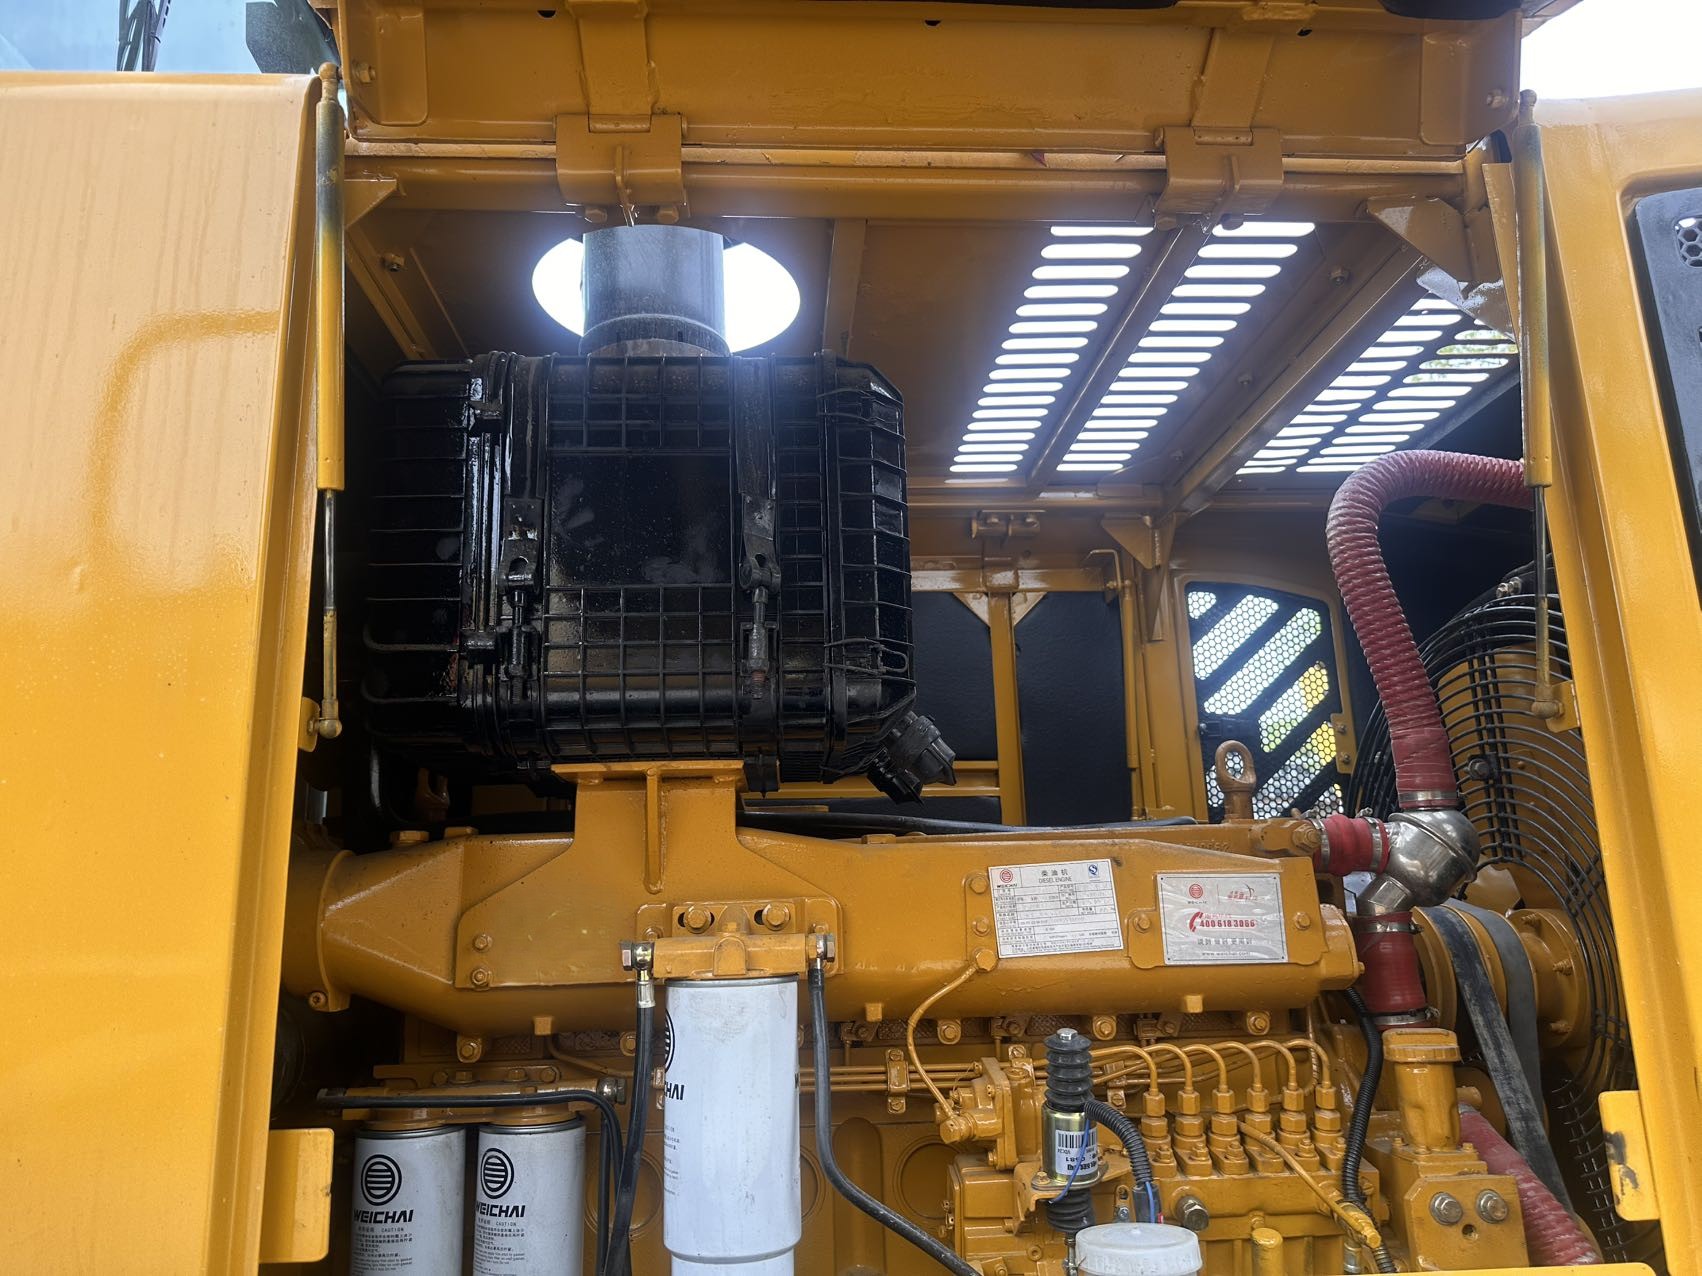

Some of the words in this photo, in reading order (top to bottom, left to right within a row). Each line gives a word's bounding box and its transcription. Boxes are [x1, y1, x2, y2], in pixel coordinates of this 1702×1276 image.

[1200, 919, 1215, 928] 400
[1217, 919, 1232, 928] 618
[353, 1209, 414, 1224] WEICHAI
